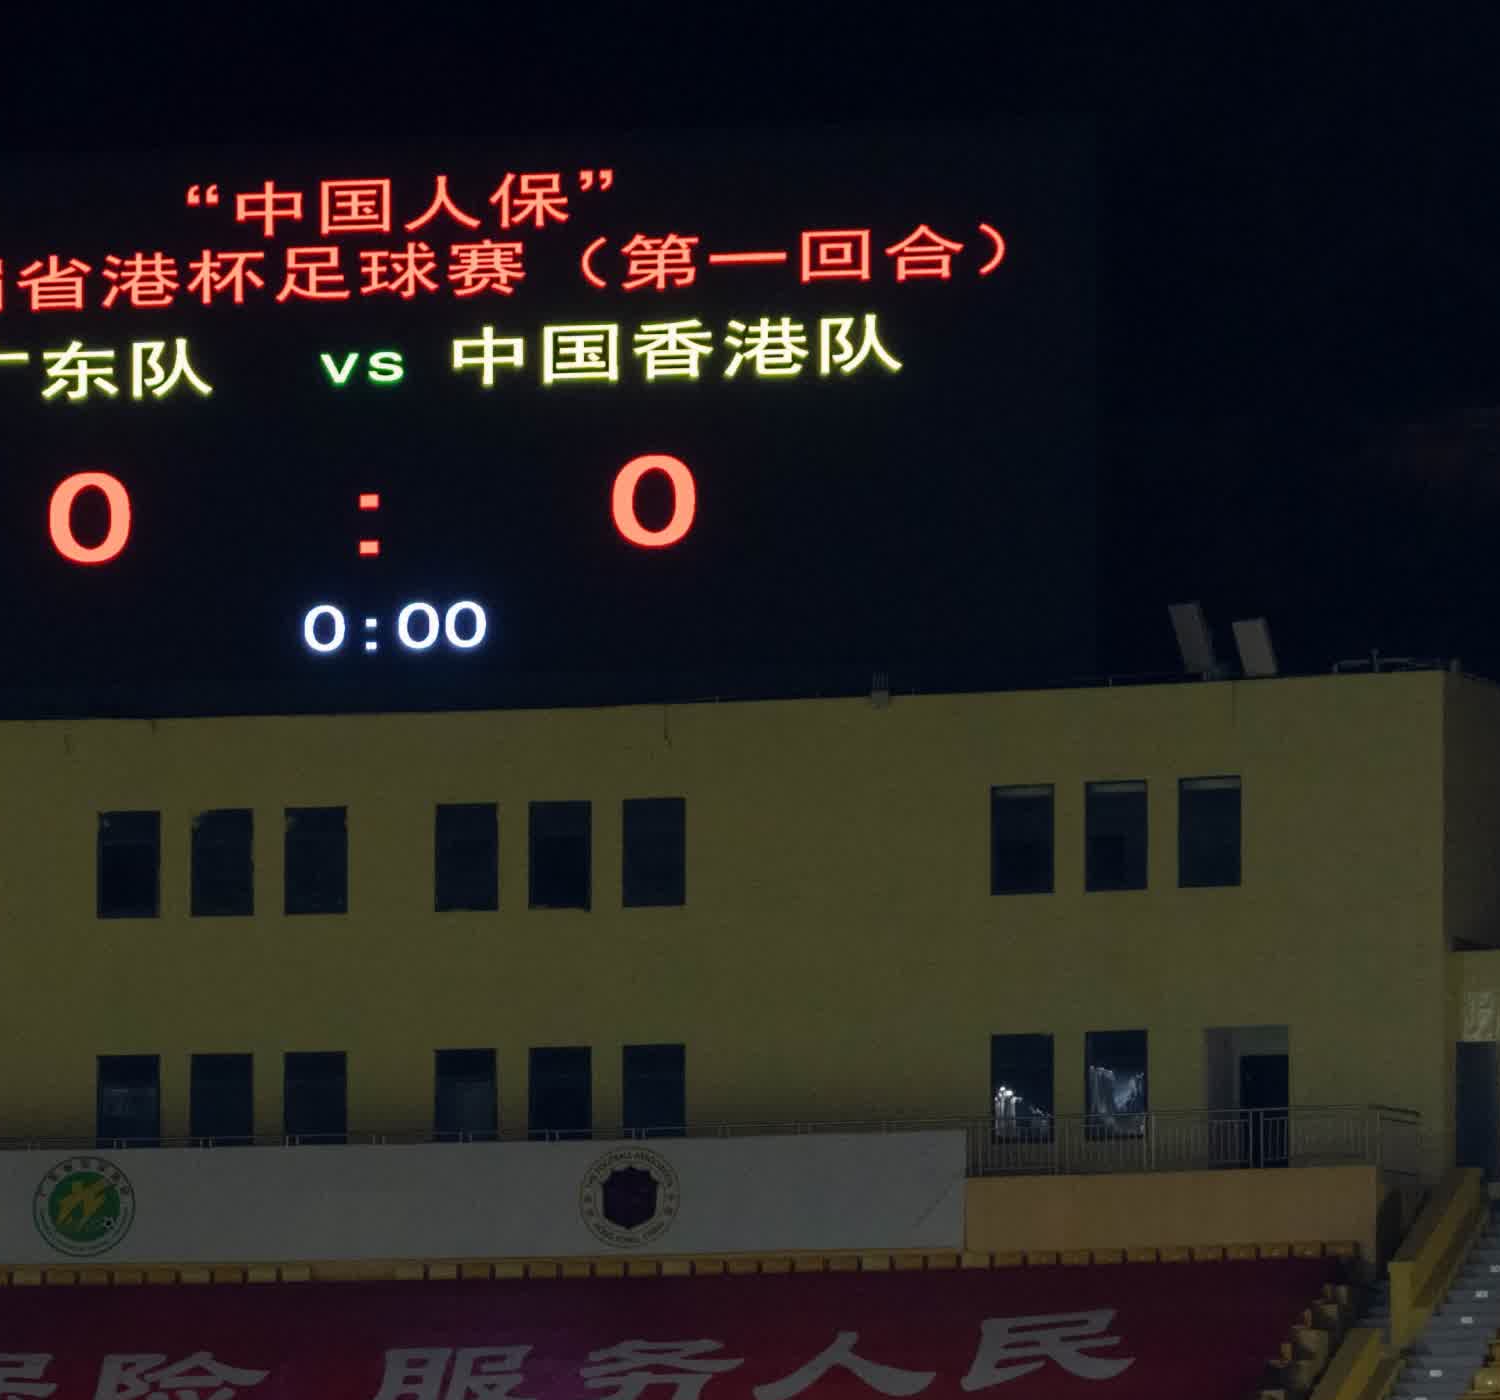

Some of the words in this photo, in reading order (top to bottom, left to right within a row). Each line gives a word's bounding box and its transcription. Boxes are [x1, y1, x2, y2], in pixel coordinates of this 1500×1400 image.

[320, 347, 405, 388] vs
[450, 313, 904, 389] 中国香港队
[49, 471, 131, 564] 0
[612, 453, 697, 548] 0
[301, 600, 488, 655] 0:00
